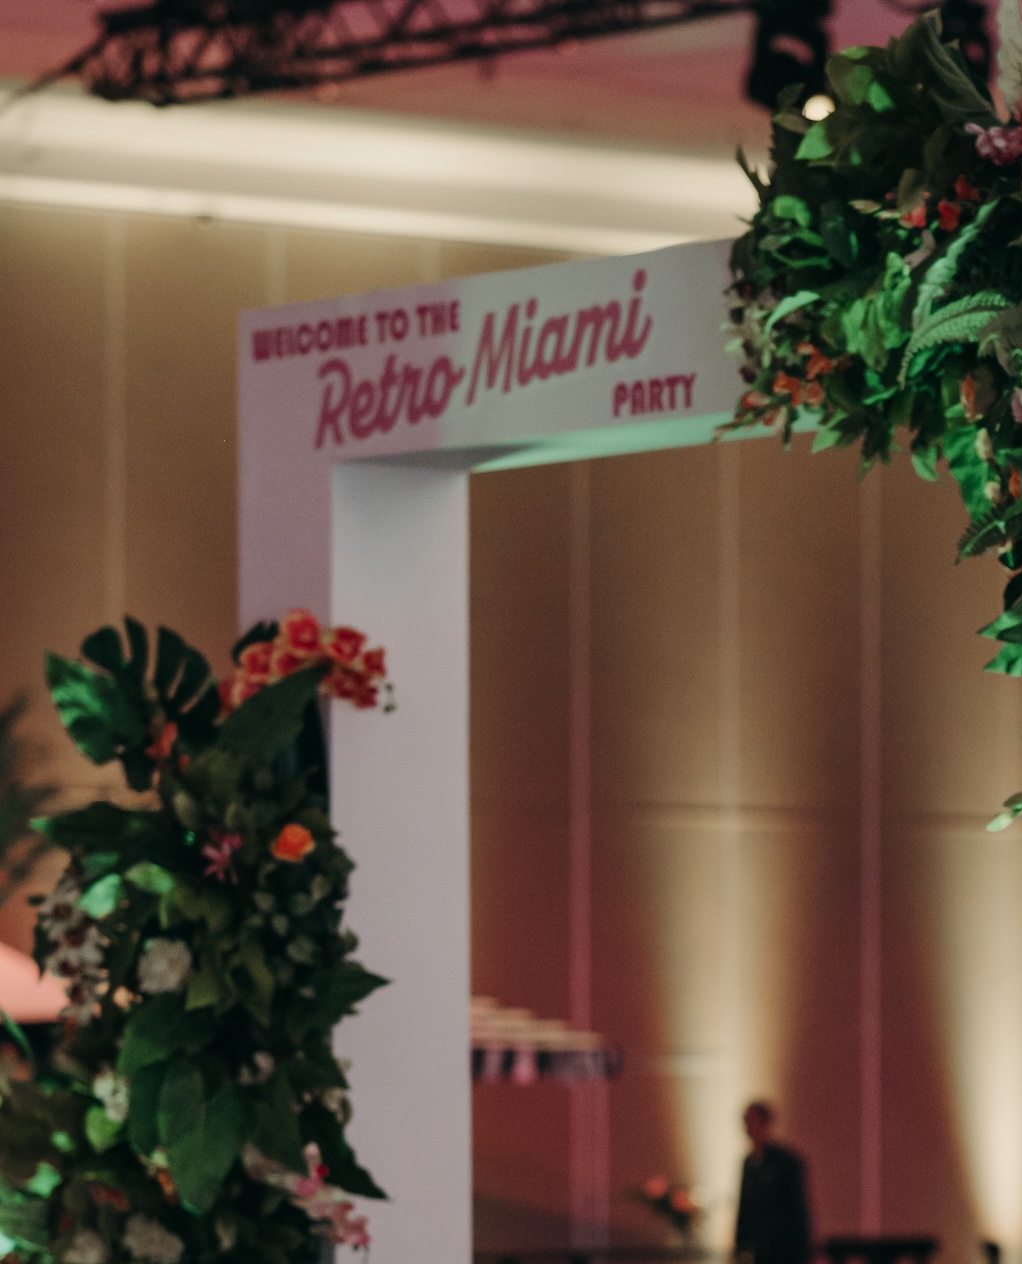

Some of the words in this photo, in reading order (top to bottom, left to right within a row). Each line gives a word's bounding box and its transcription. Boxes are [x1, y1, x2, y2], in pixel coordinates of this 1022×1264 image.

[253, 314, 367, 362] WELCOME
[377, 309, 409, 342] TO
[416, 300, 461, 337] THE
[315, 354, 464, 449] Retro
[465, 269, 652, 407] Miami
[612, 372, 696, 418] PARTY
